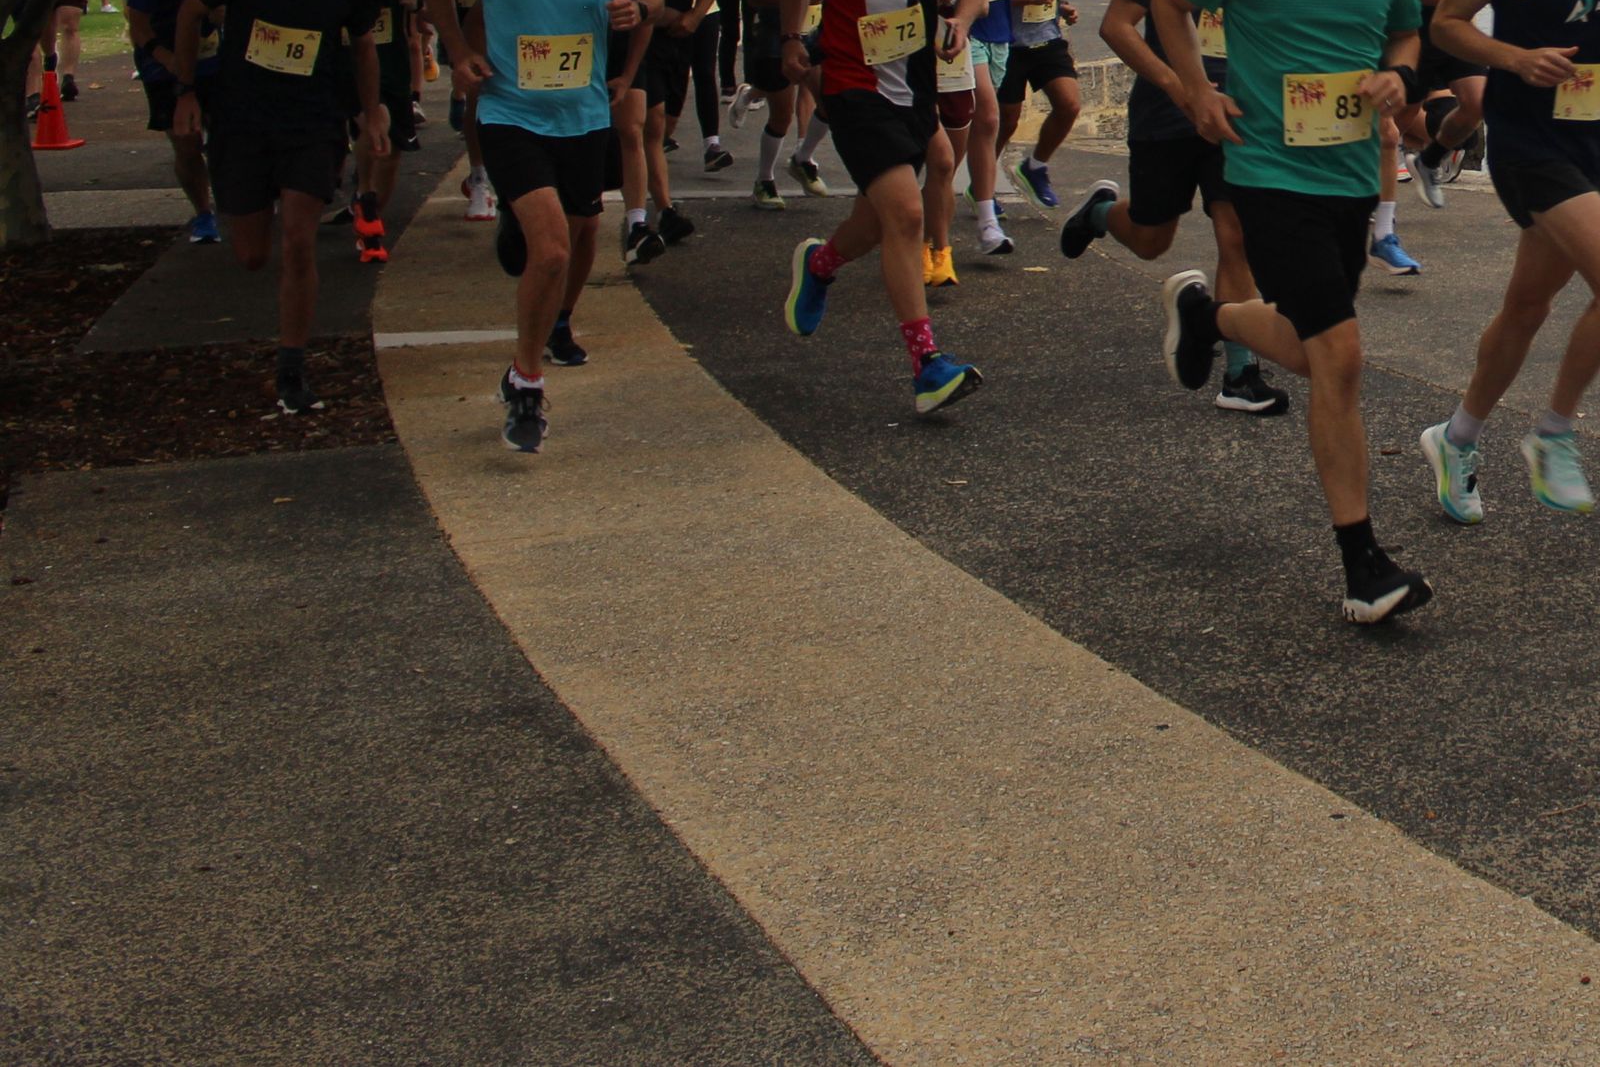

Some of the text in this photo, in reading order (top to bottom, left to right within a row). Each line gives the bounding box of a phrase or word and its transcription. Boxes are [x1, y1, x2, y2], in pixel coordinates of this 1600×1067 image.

[895, 22, 916, 41] 72
[286, 43, 304, 59] 18
[559, 51, 582, 71] 27
[1335, 94, 1362, 120] 83
